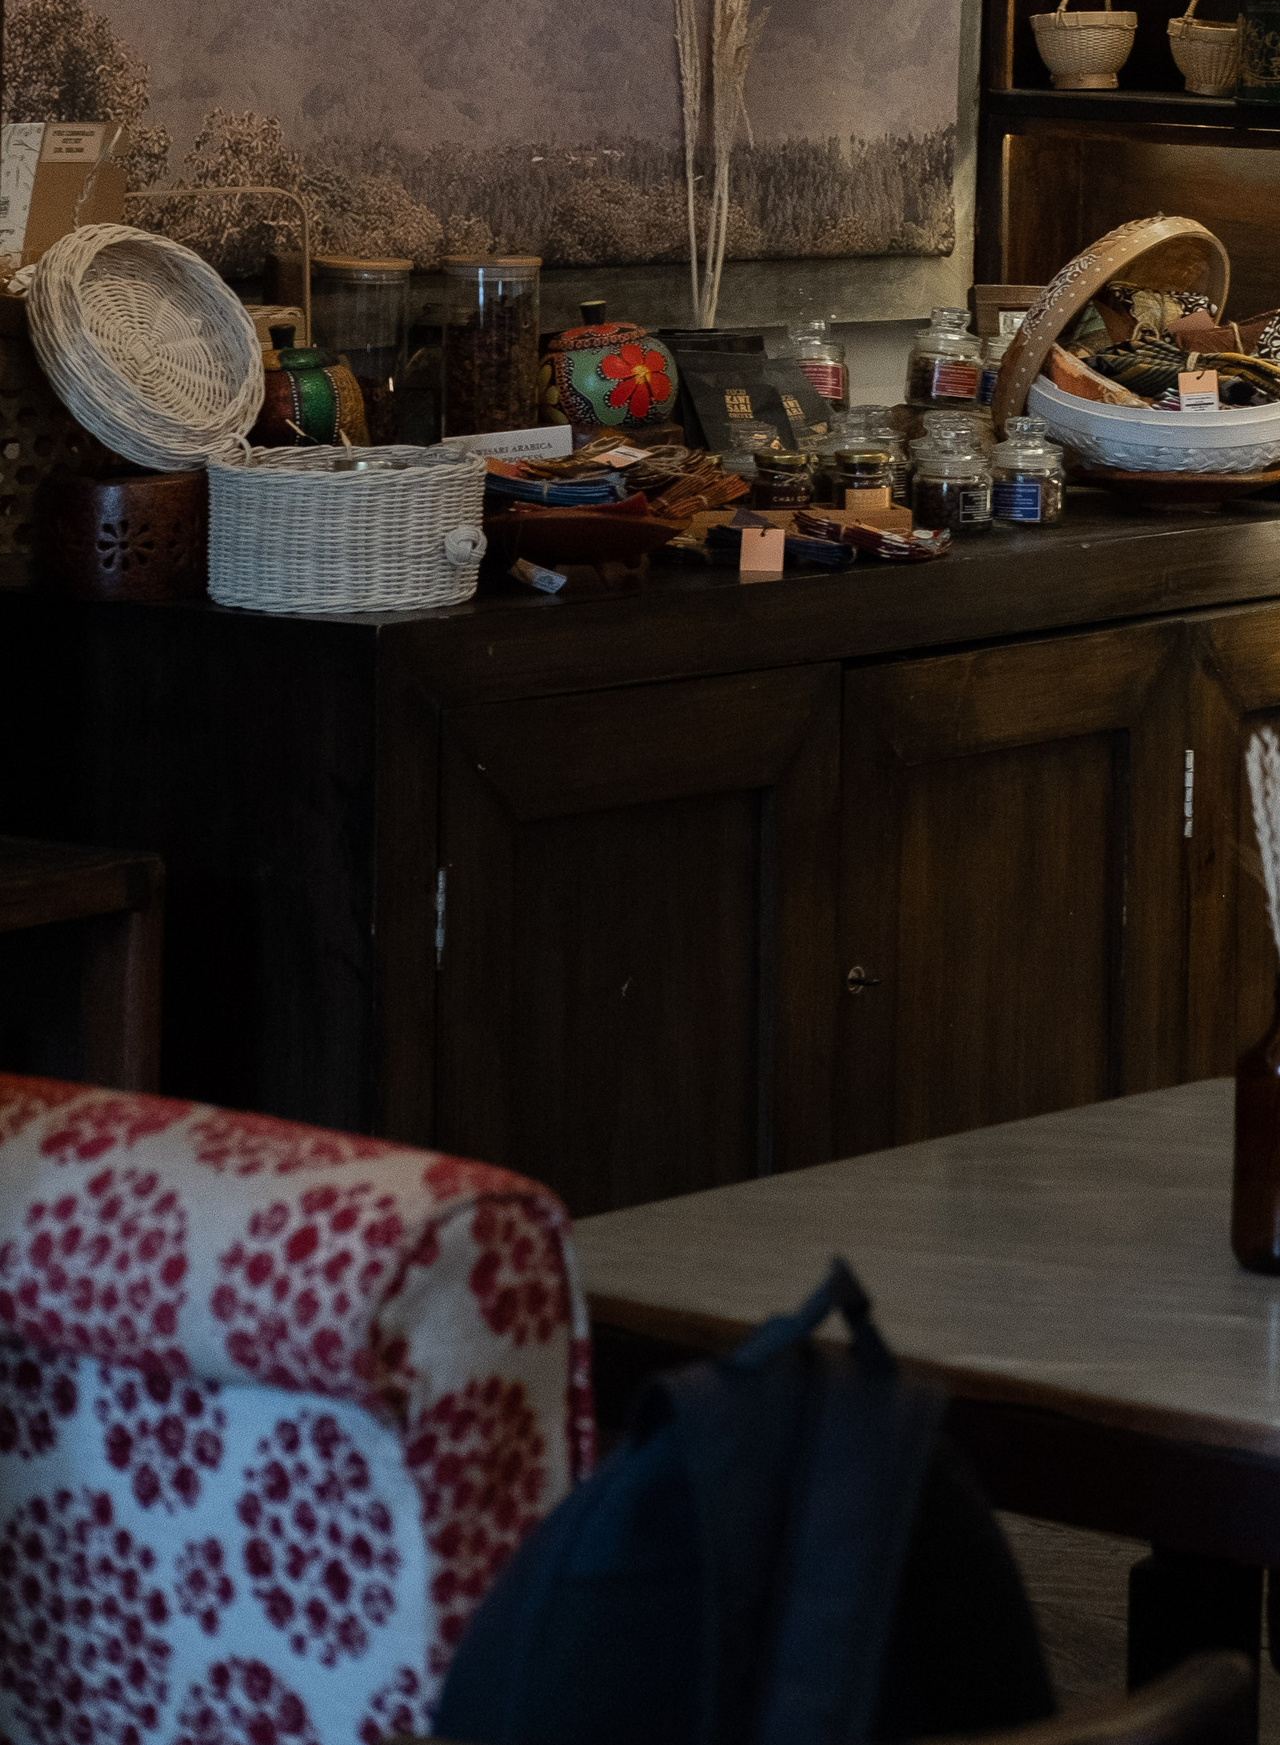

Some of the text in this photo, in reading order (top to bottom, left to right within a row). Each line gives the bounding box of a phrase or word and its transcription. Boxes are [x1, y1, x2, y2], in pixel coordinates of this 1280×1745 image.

[725, 395, 750, 404] KAWI
[726, 404, 752, 412] SARI
[512, 442, 553, 452] ARABICA
